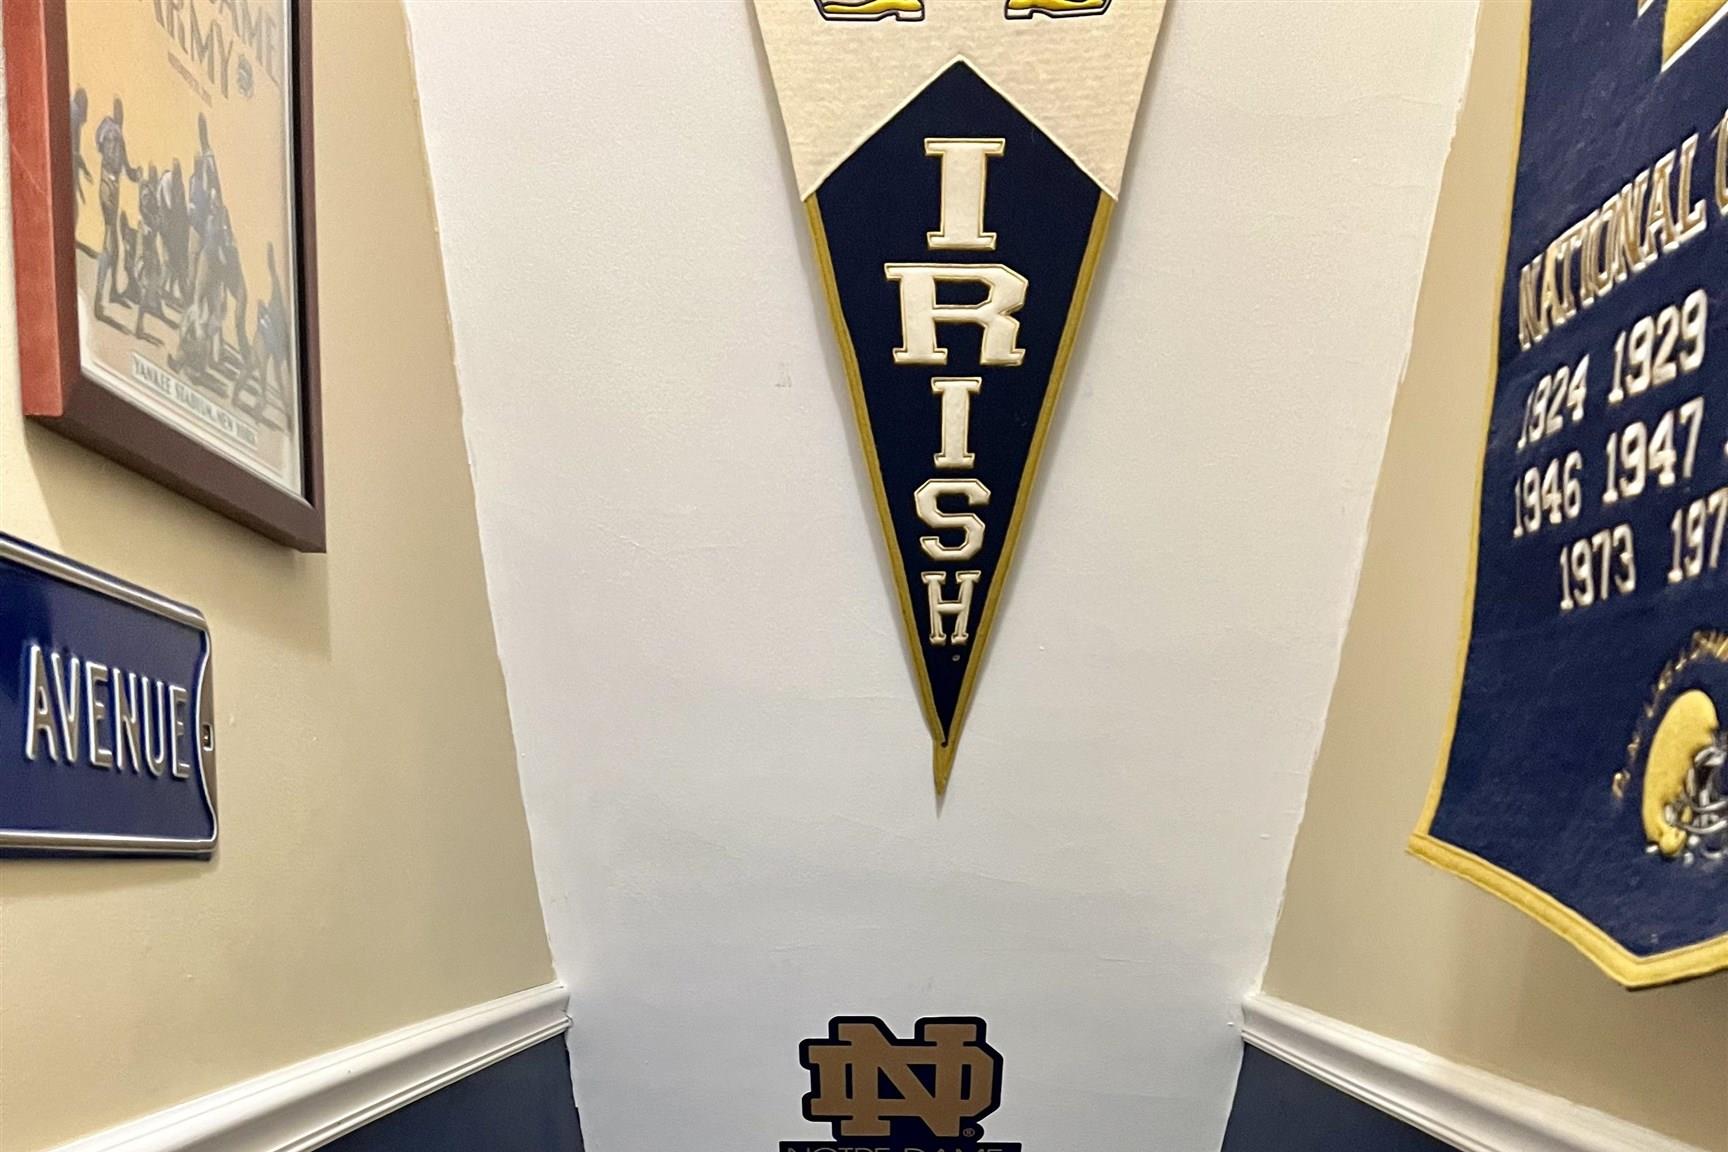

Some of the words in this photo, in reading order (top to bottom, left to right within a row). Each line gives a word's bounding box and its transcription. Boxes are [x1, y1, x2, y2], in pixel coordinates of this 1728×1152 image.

[1518, 132, 1706, 351] NATIONAL
[884, 137, 1026, 645] IRISH
[1517, 353, 1590, 449] 1924
[1608, 289, 1708, 404] 1929
[1513, 451, 1583, 539] 1946
[1602, 396, 1704, 503] 1947
[1560, 523, 1637, 611] 1973
[26, 645, 190, 778] AVENUE
